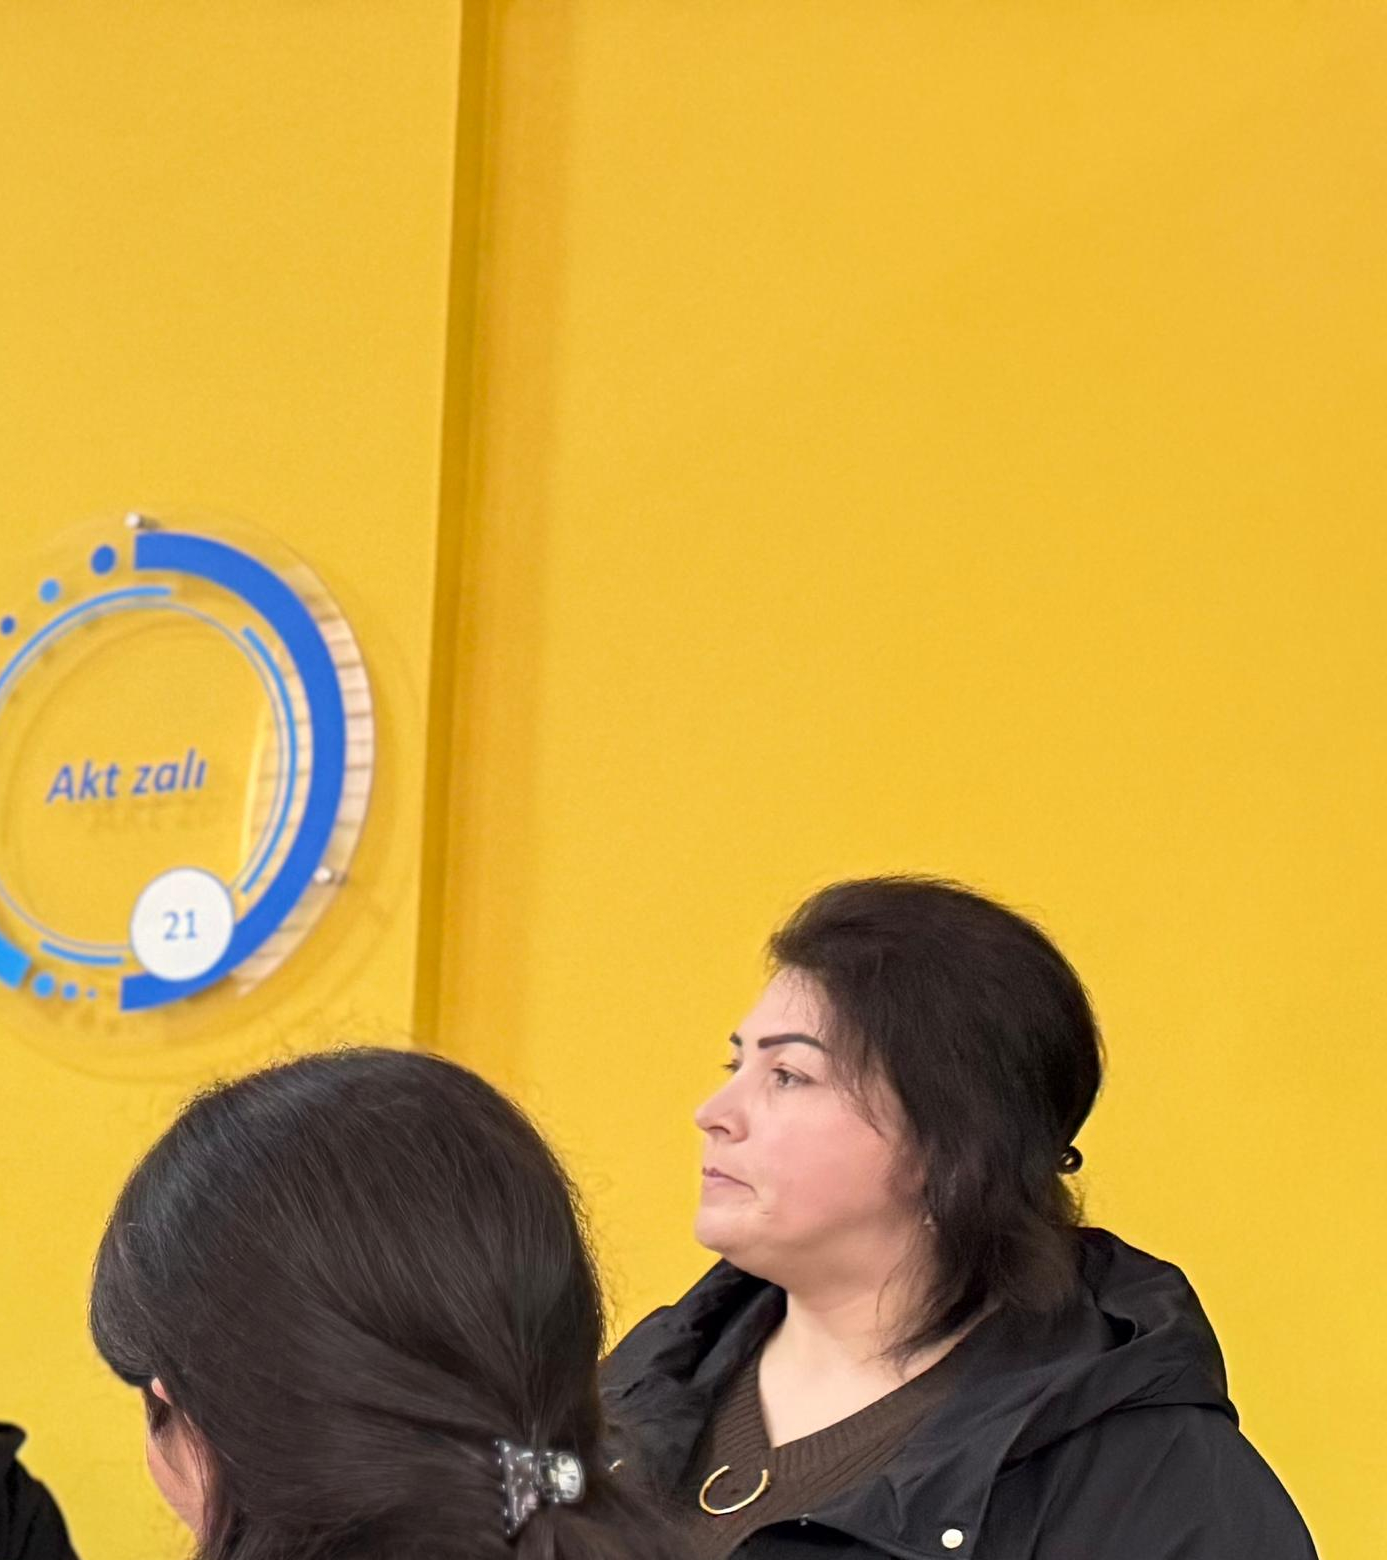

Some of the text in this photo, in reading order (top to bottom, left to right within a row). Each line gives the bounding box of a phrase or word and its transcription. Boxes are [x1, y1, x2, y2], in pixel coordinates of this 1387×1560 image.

[45, 747, 207, 804] Akt zalı
[162, 909, 197, 941] 21
